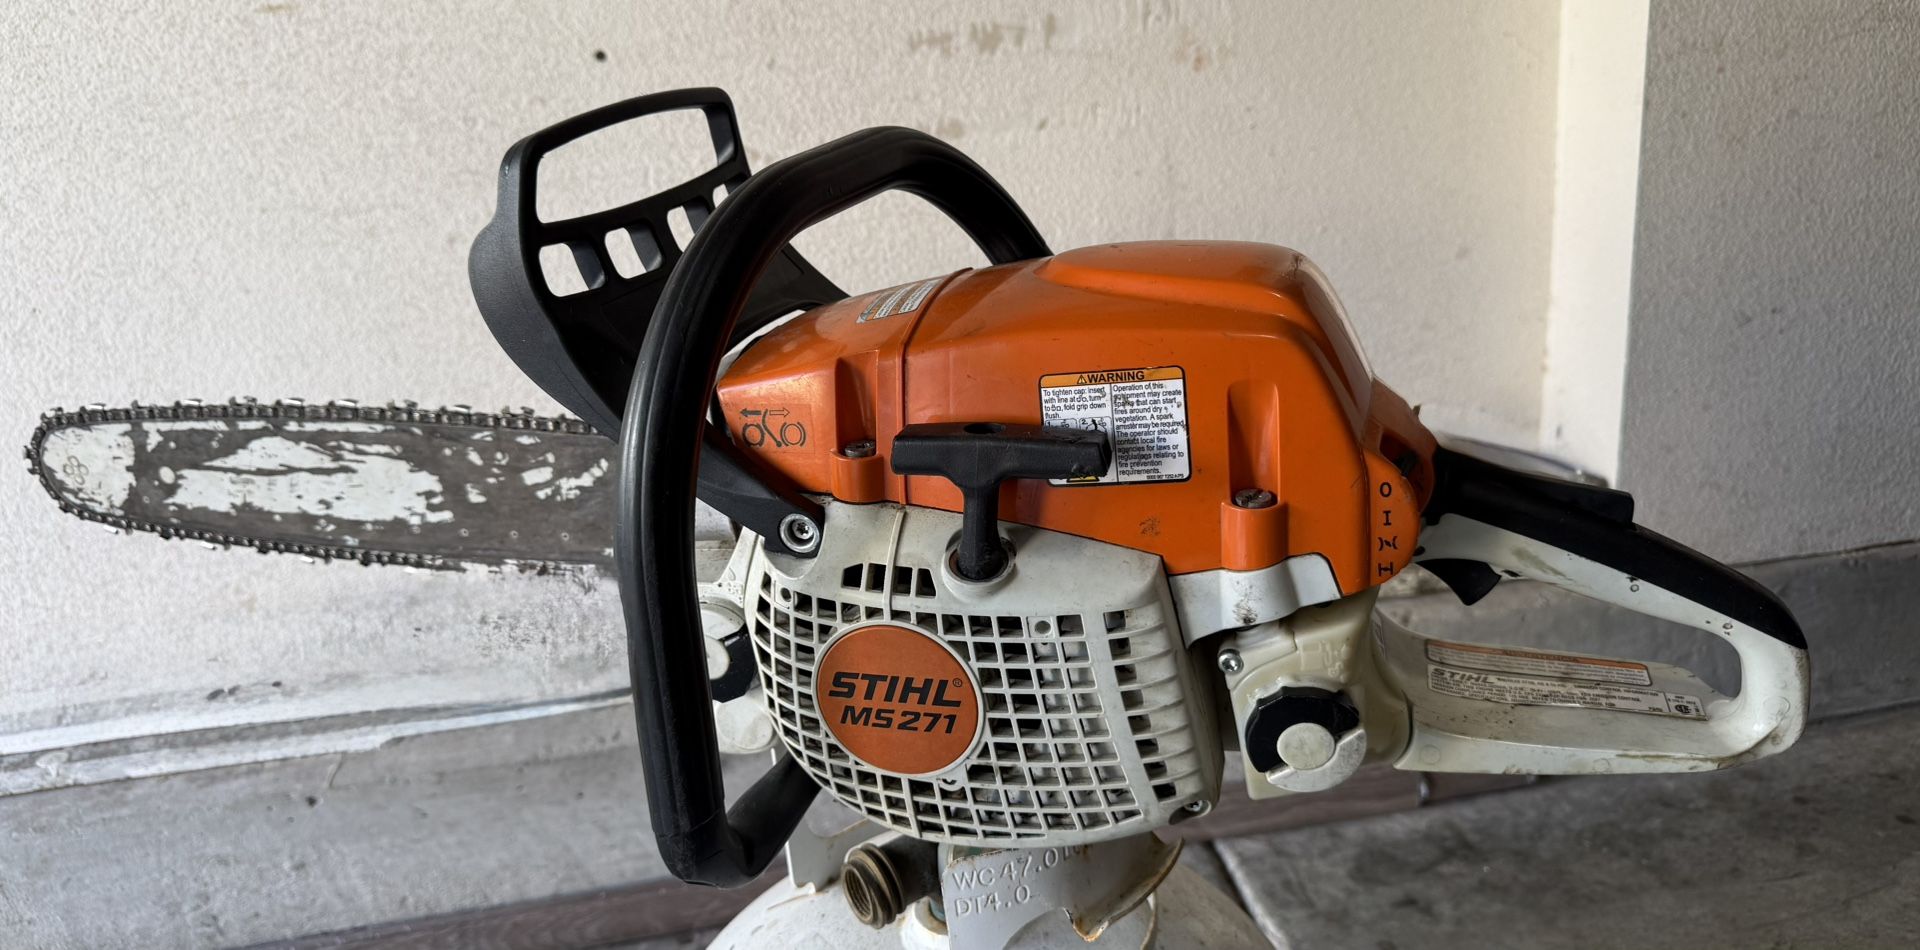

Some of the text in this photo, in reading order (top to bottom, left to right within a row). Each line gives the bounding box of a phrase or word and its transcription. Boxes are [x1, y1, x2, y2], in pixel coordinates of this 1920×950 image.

[1087, 371, 1144, 383] WARNING
[1113, 384, 1143, 392] Operation
[1118, 446, 1145, 454] agencies
[1130, 461, 1162, 469] prevention
[1433, 668, 1494, 683] STIHL
